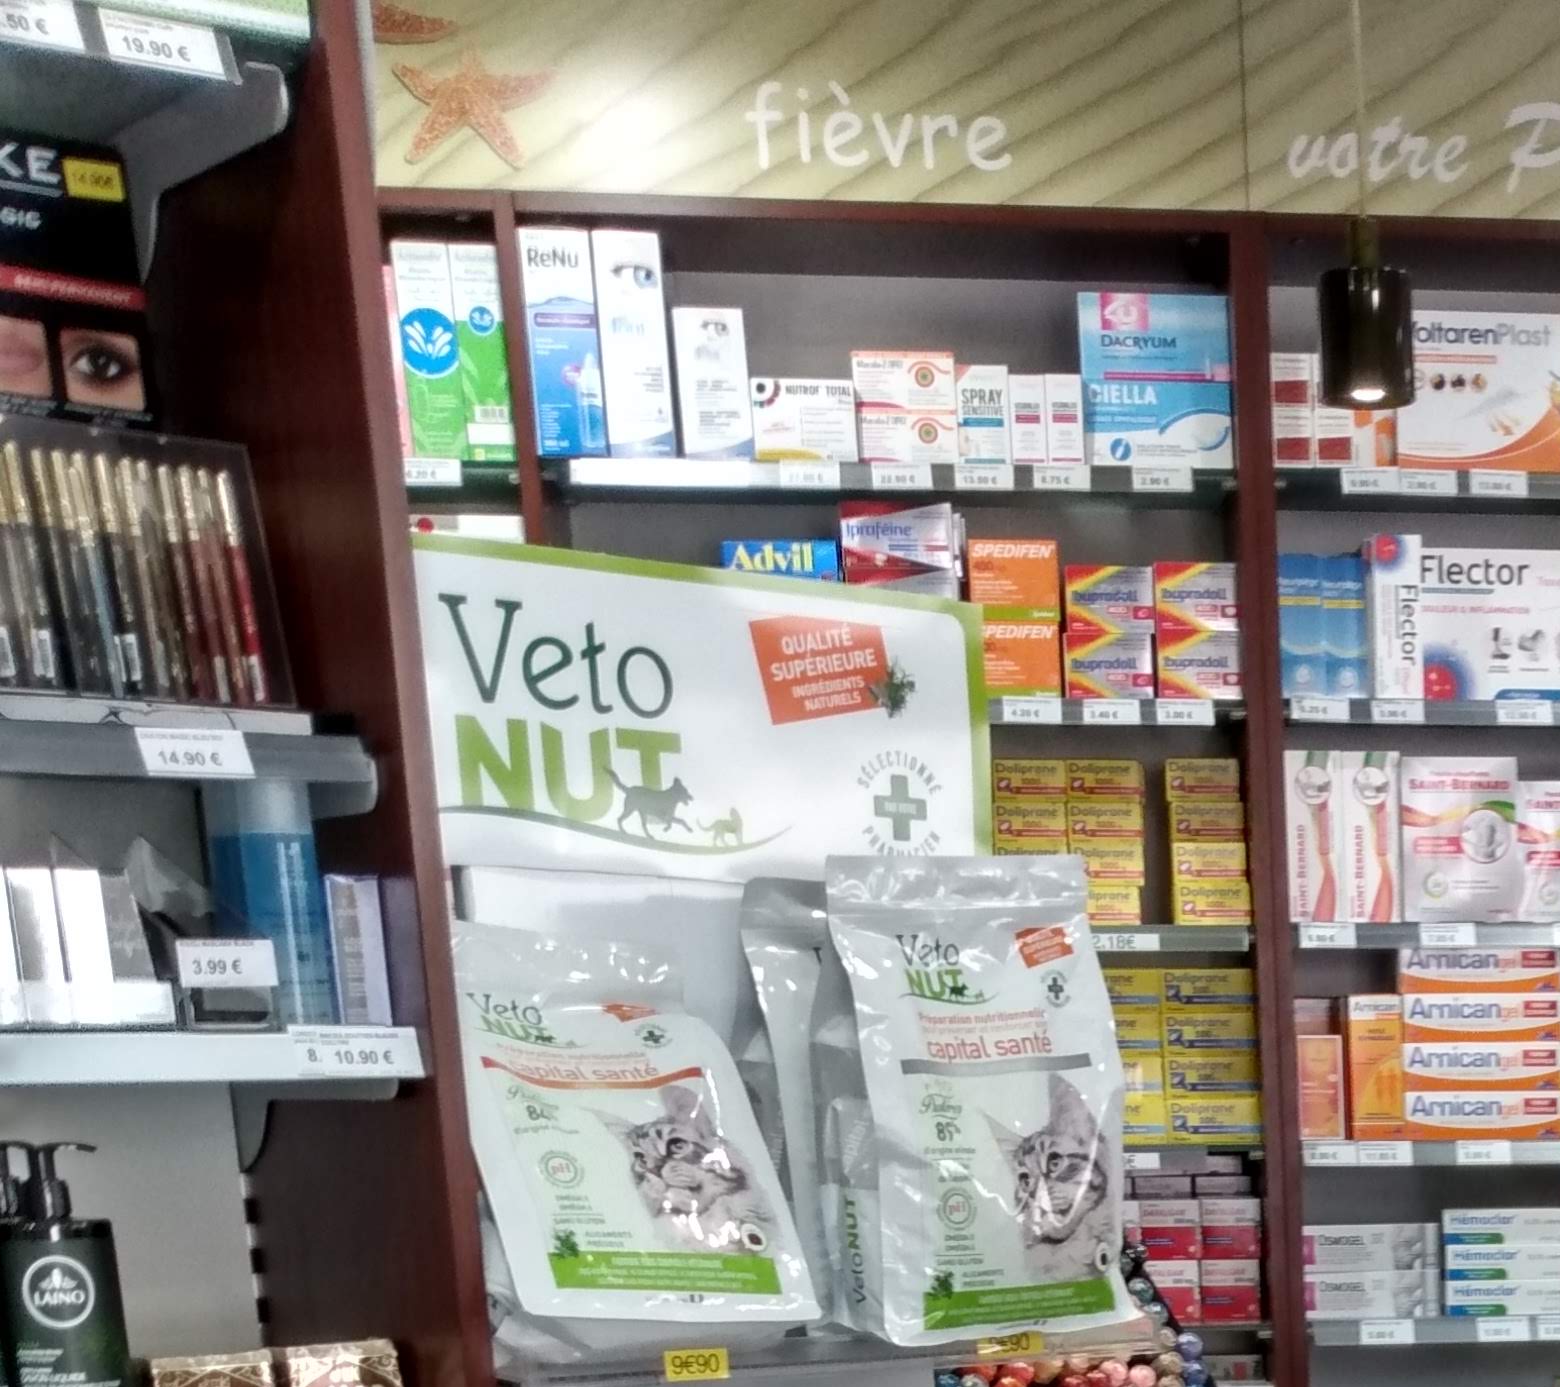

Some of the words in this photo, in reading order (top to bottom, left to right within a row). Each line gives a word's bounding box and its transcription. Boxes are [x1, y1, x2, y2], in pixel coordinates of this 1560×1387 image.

[36, 19, 48, 35] €
[123, 36, 172, 59] 19.90
[178, 46, 190, 62] €
[745, 81, 1013, 171] fièvre
[1288, 116, 1470, 183] votre
[526, 245, 580, 269] ReNu
[1101, 334, 1177, 350] DACRYUM
[961, 388, 1002, 405] SPRAY
[727, 542, 812, 572] Advil
[972, 543, 1055, 560] SPEDIFEN
[1421, 555, 1530, 588] Flector
[1400, 584, 1416, 666] Flector
[781, 624, 853, 655] QUALITÉ
[438, 594, 674, 717] Veto
[771, 649, 877, 682] SUPÉRIEURE
[804, 692, 861, 711] NATURELS
[158, 751, 206, 767] 14.90
[210, 752, 222, 767] €
[454, 714, 682, 819] NUT
[897, 935, 960, 968] Veto
[193, 959, 226, 976] 3.99
[230, 959, 242, 974] €
[334, 1048, 379, 1065] 10.90
[381, 1048, 394, 1064] €
[927, 1034, 990, 1061] capital
[996, 1031, 1052, 1057] santé
[671, 1353, 720, 1375] 9€90
